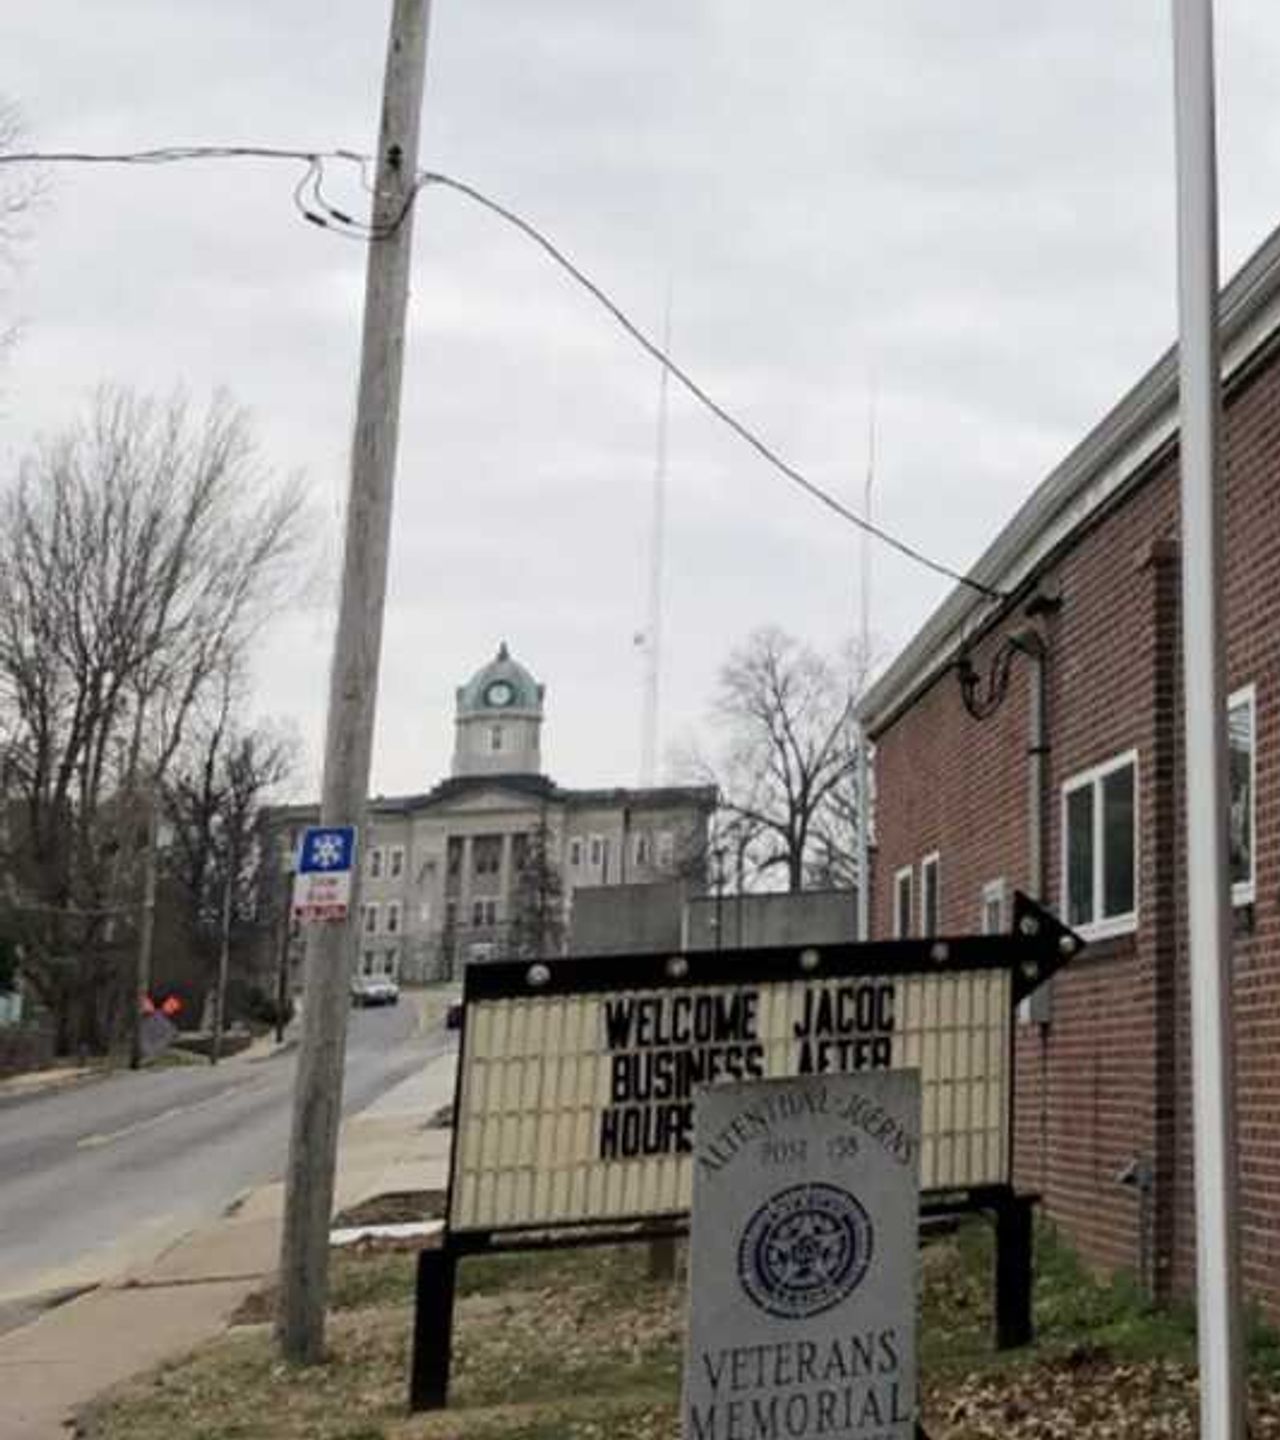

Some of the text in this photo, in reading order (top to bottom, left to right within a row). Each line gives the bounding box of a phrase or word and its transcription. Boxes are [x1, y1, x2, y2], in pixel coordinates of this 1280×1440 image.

[605, 985, 895, 1049] WELCOME JACOC
[611, 1036, 892, 1102] BUSINESS AFTER
[702, 1326, 900, 1392] VETERANS
[690, 1382, 910, 1440] MEMORIAL
